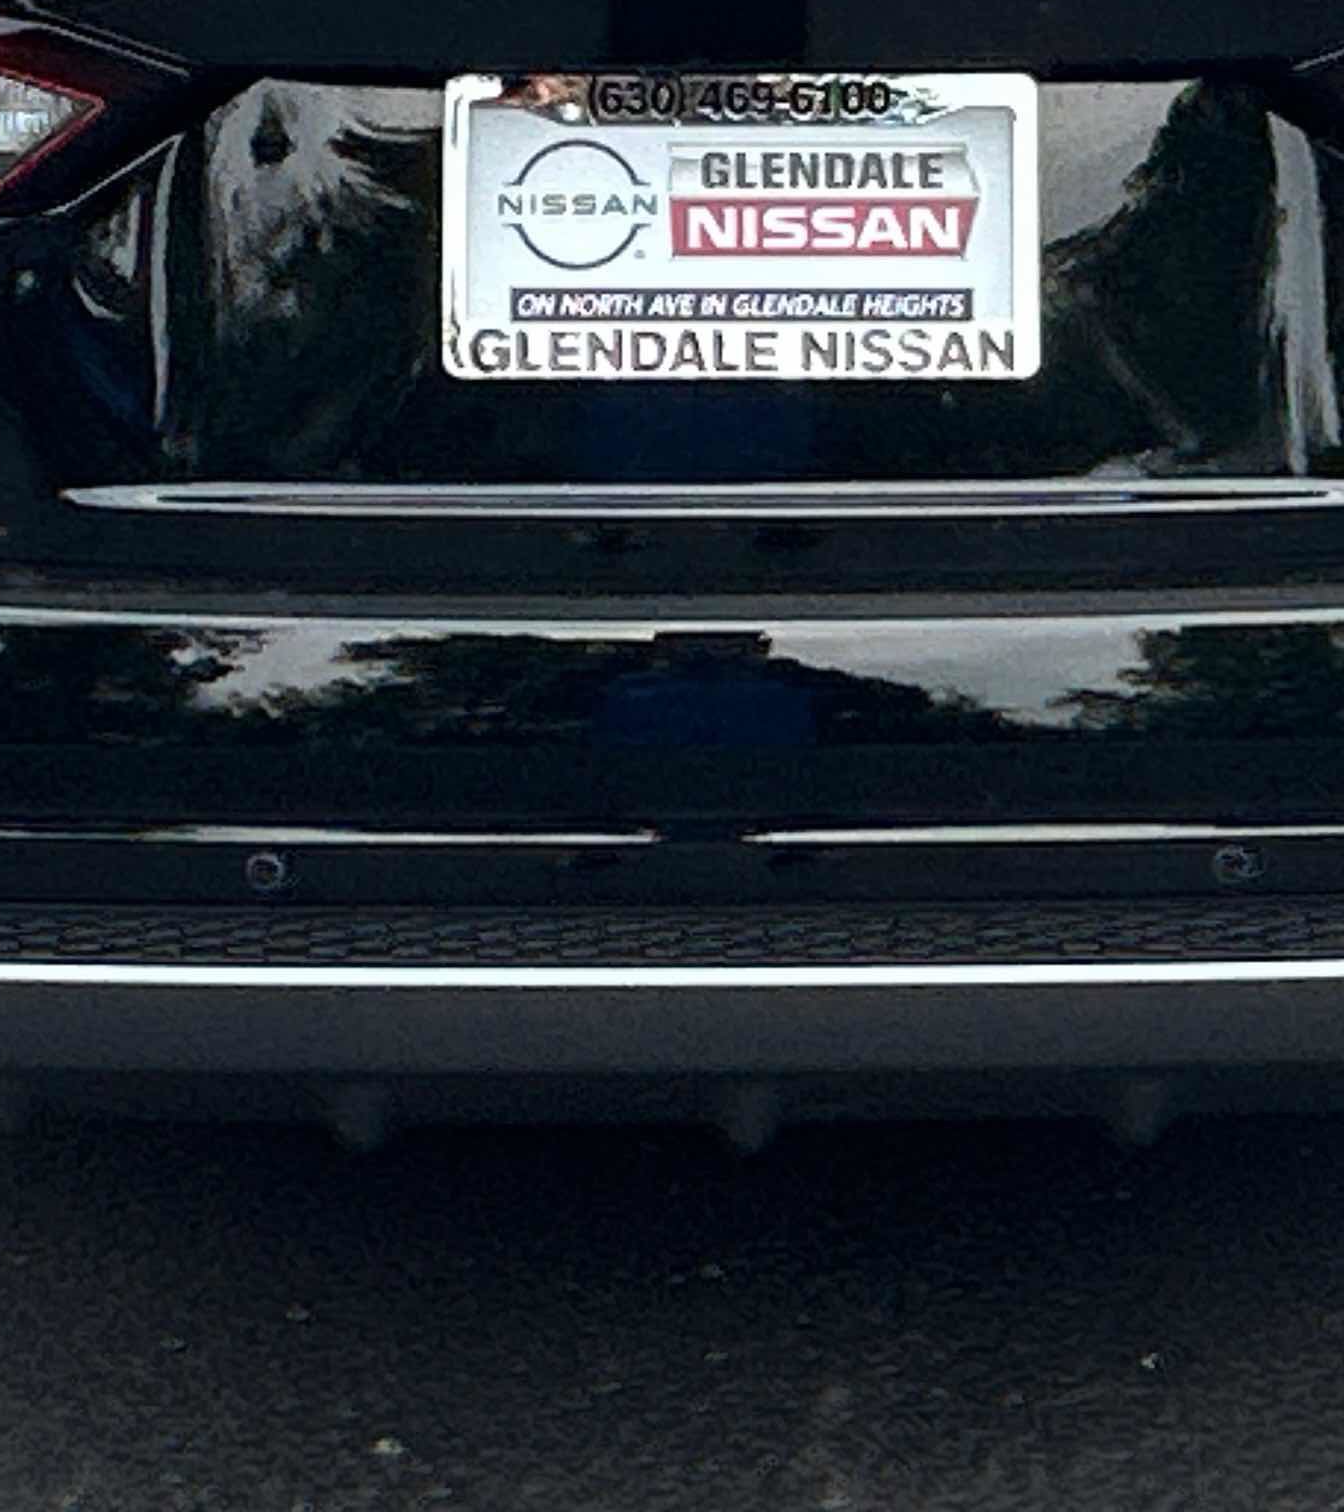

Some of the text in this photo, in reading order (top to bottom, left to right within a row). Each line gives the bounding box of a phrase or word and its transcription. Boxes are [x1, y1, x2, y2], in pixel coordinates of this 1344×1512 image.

[588, 76, 891, 120] (630) 469-6100
[701, 152, 944, 189] GLENDALE
[498, 194, 658, 216] NISSAN
[687, 205, 960, 249] NISSAN
[517, 293, 965, 317] ON NORTH AVE IN GLENDALE HEIGHTS
[468, 328, 1015, 373] GLENDALE NISSAN
